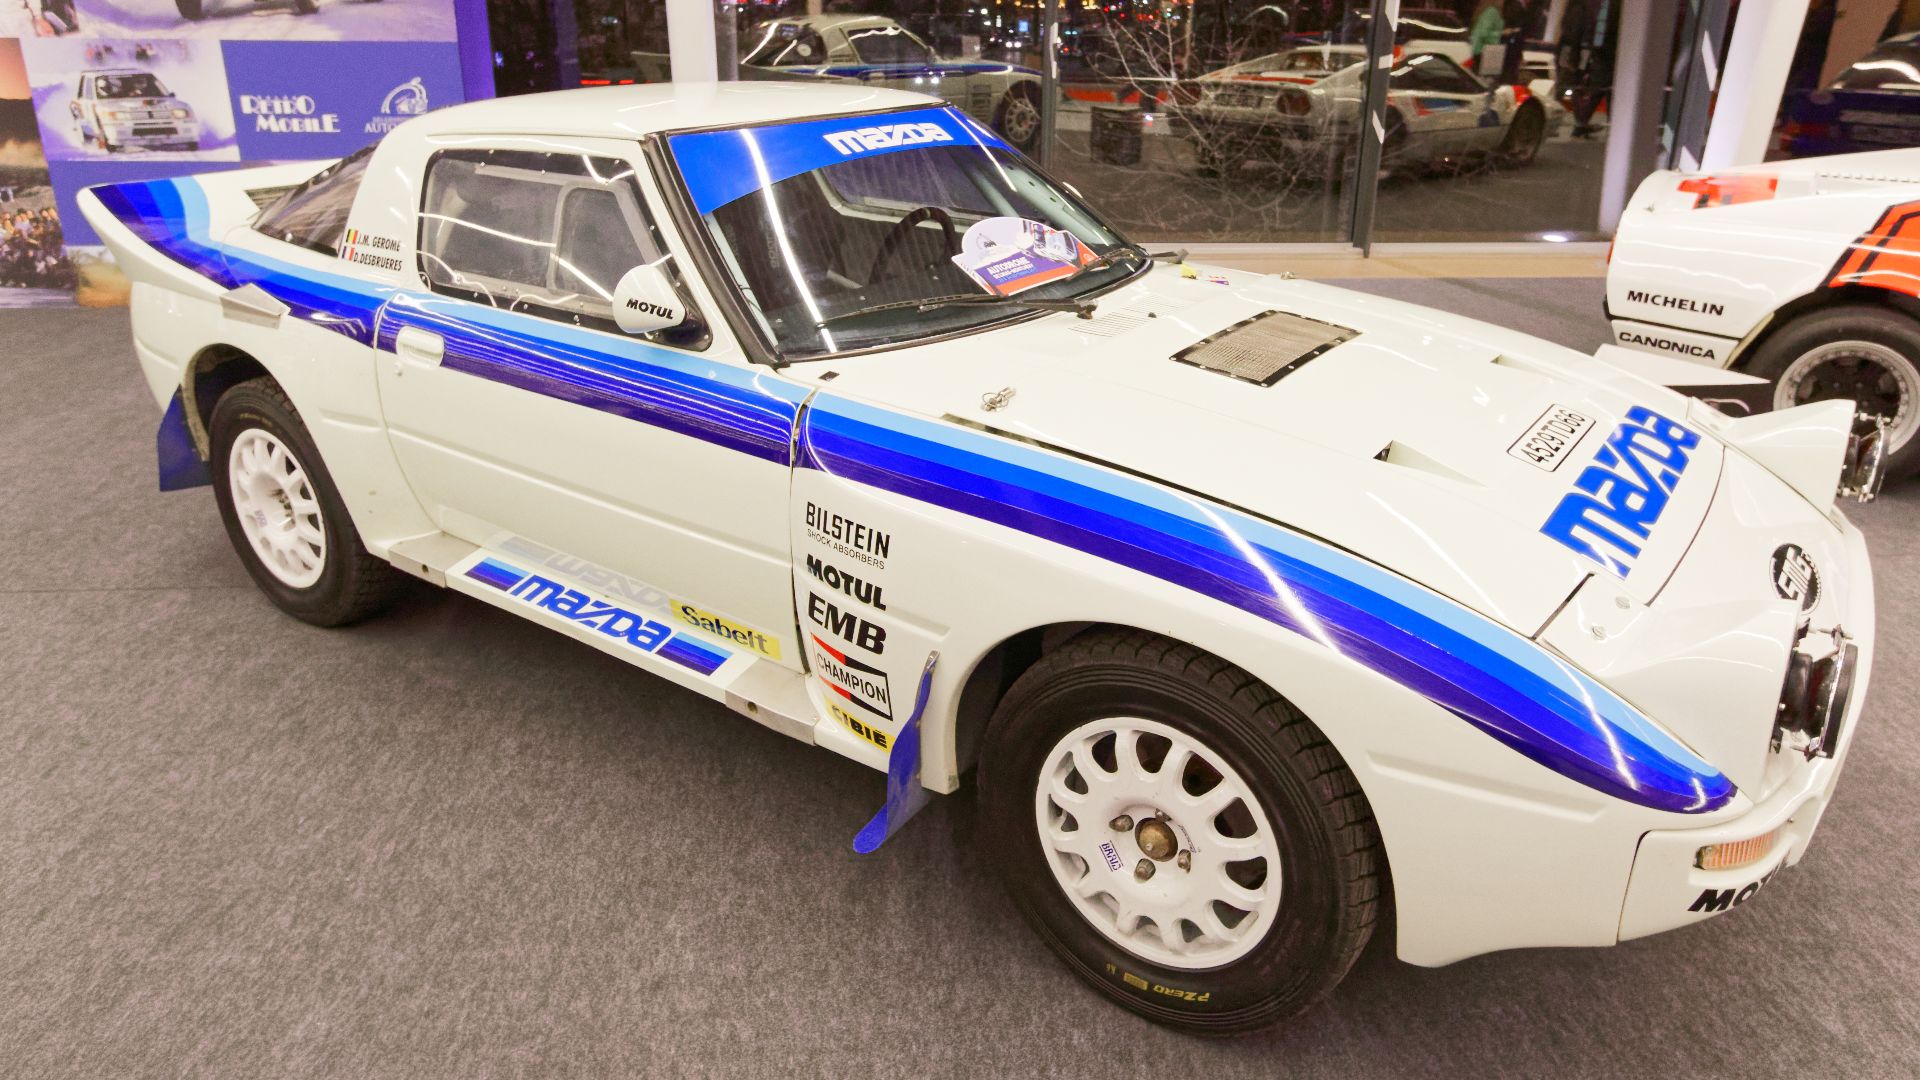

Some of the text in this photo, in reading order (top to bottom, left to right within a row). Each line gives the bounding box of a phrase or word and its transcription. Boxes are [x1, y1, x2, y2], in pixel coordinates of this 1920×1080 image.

[256, 114, 341, 133] MOBILE
[372, 236, 401, 252] GEROME
[626, 297, 674, 320] MOTUL
[1626, 288, 1724, 317] MICHELIN
[1618, 330, 1716, 361] CANONICA
[806, 501, 891, 560] BILSTEIN
[807, 528, 886, 570] SHOCK ABSORBERS
[806, 553, 887, 612] MOTUL
[680, 605, 769, 656] Sabelt
[808, 591, 888, 656] EMB
[816, 651, 888, 705] CHAMPION
